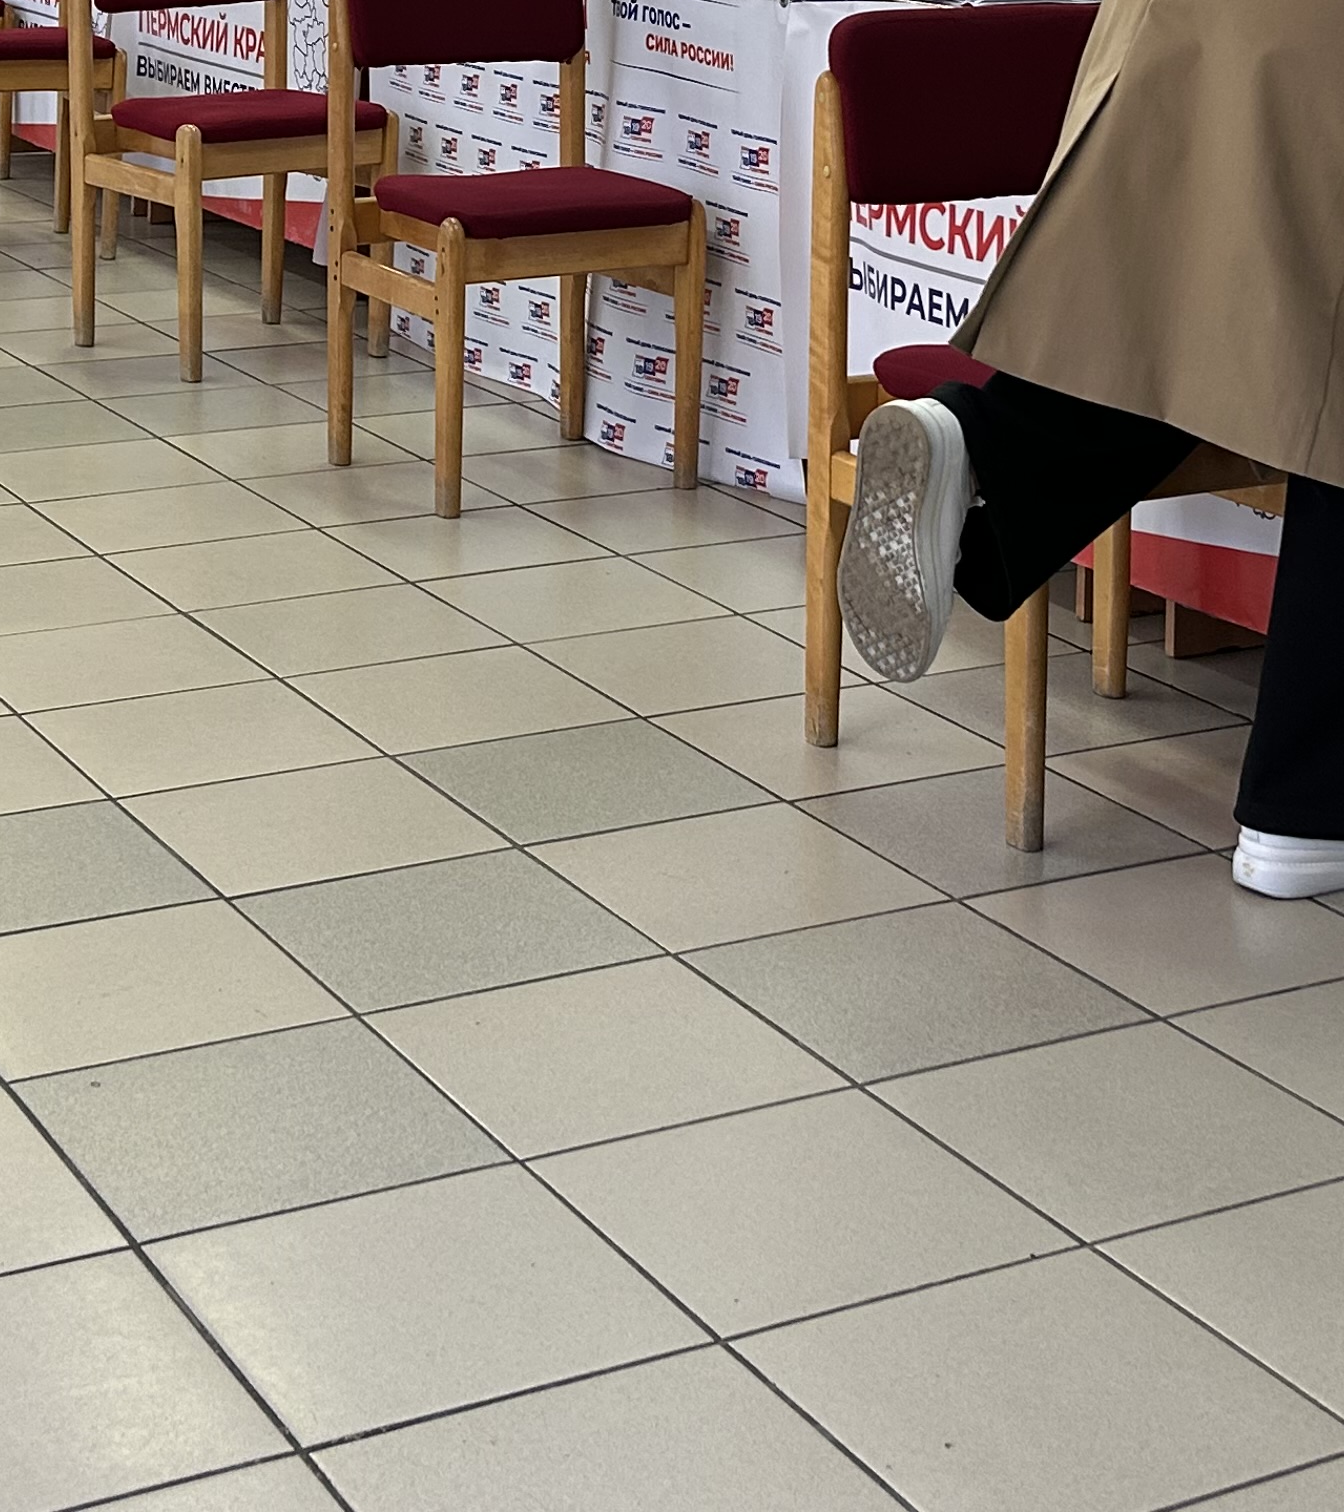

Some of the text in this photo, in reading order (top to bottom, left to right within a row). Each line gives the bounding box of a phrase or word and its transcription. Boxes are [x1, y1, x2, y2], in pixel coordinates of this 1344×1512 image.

[139, 10, 266, 64] ПЕРМСКИЙ КРА
[611, 0, 638, 22] ТВОЙ
[642, 5, 680, 30] ГОЛОС
[136, 55, 200, 92] ВЫБИРАЕМ
[646, 33, 735, 72] СИЛА РОССИИ!
[850, 203, 1026, 263] ЕРМСКИЙ
[850, 257, 969, 328] ЫБИРАЕМ
